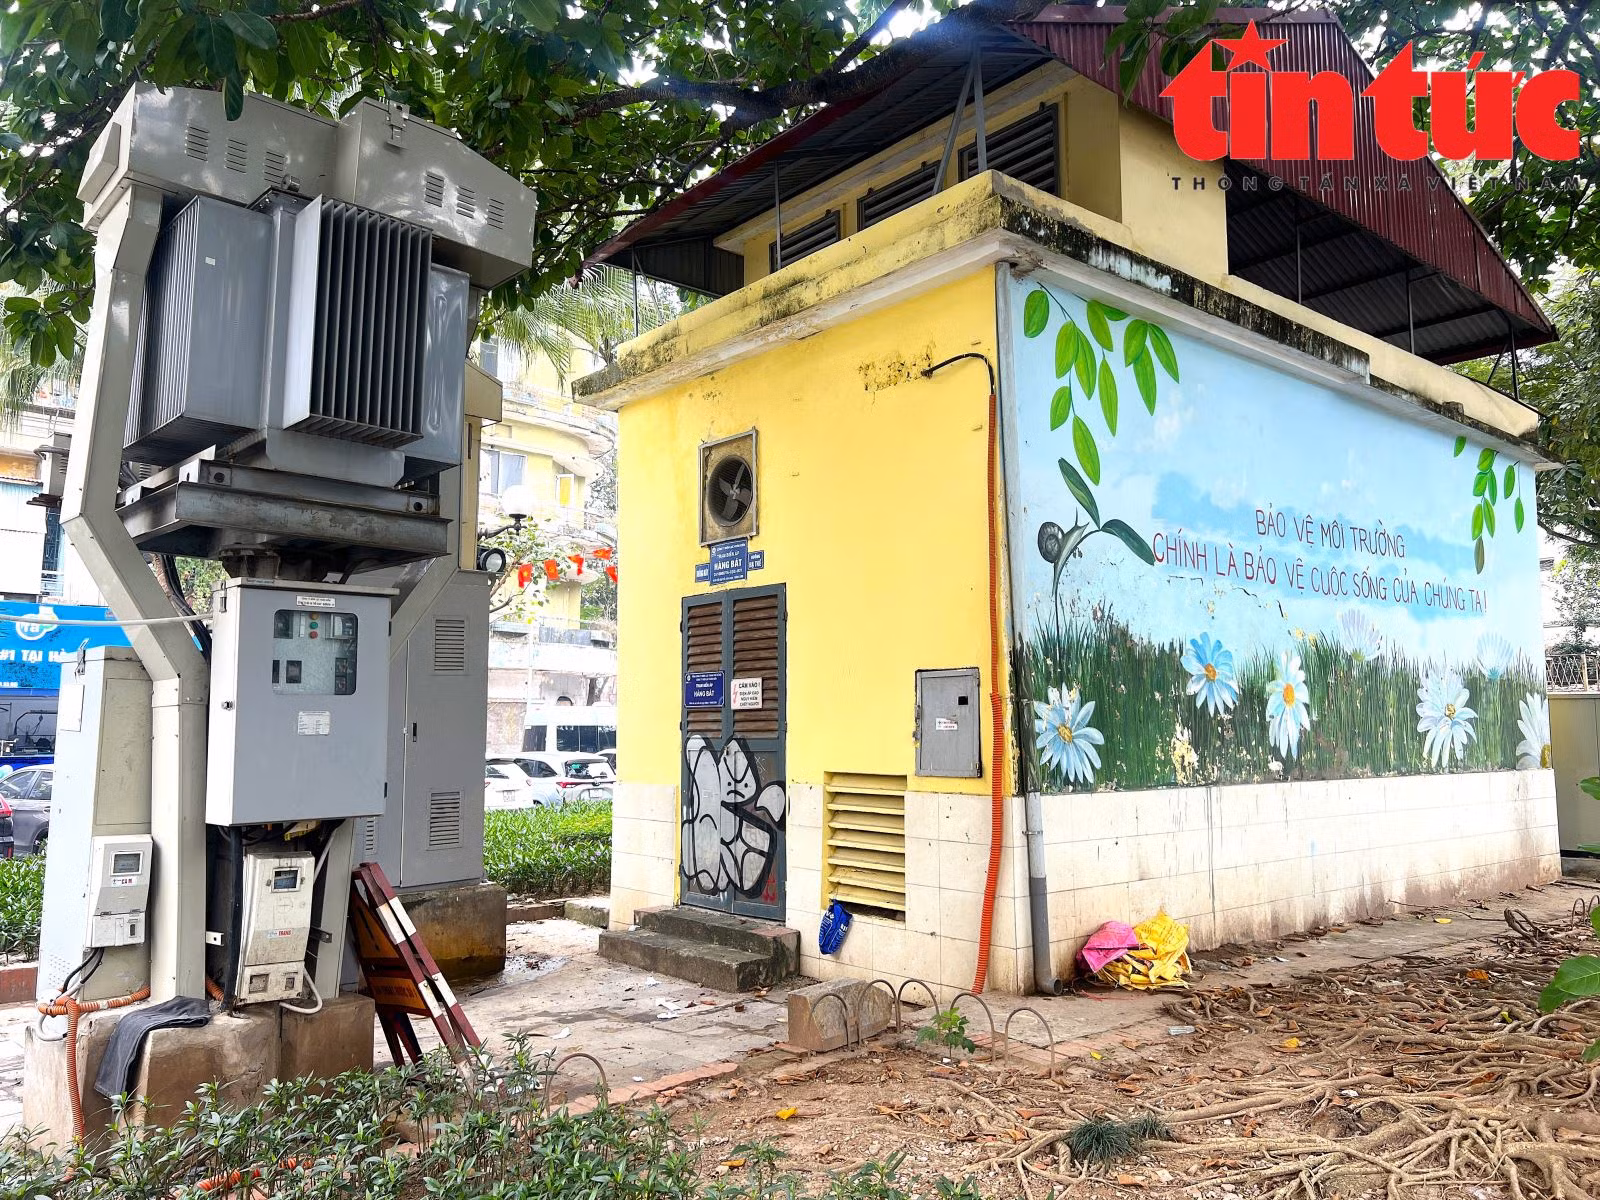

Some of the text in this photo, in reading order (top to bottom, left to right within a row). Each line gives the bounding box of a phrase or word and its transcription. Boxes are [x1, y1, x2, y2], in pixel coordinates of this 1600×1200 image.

[1255, 502, 1286, 538] BẢO
[1294, 514, 1314, 548] VỆ
[1349, 519, 1406, 558] TRƯỜNG
[1153, 528, 1208, 572] CHÍNH
[1214, 542, 1239, 578] LÀ
[1244, 545, 1277, 585] BẢO
[1284, 557, 1306, 595] VỆ
[1311, 566, 1348, 601] CUỘC
[1353, 566, 1387, 600] SỐNG
[1393, 567, 1419, 605] CỦA
[1424, 577, 1466, 611] CHÚNG
